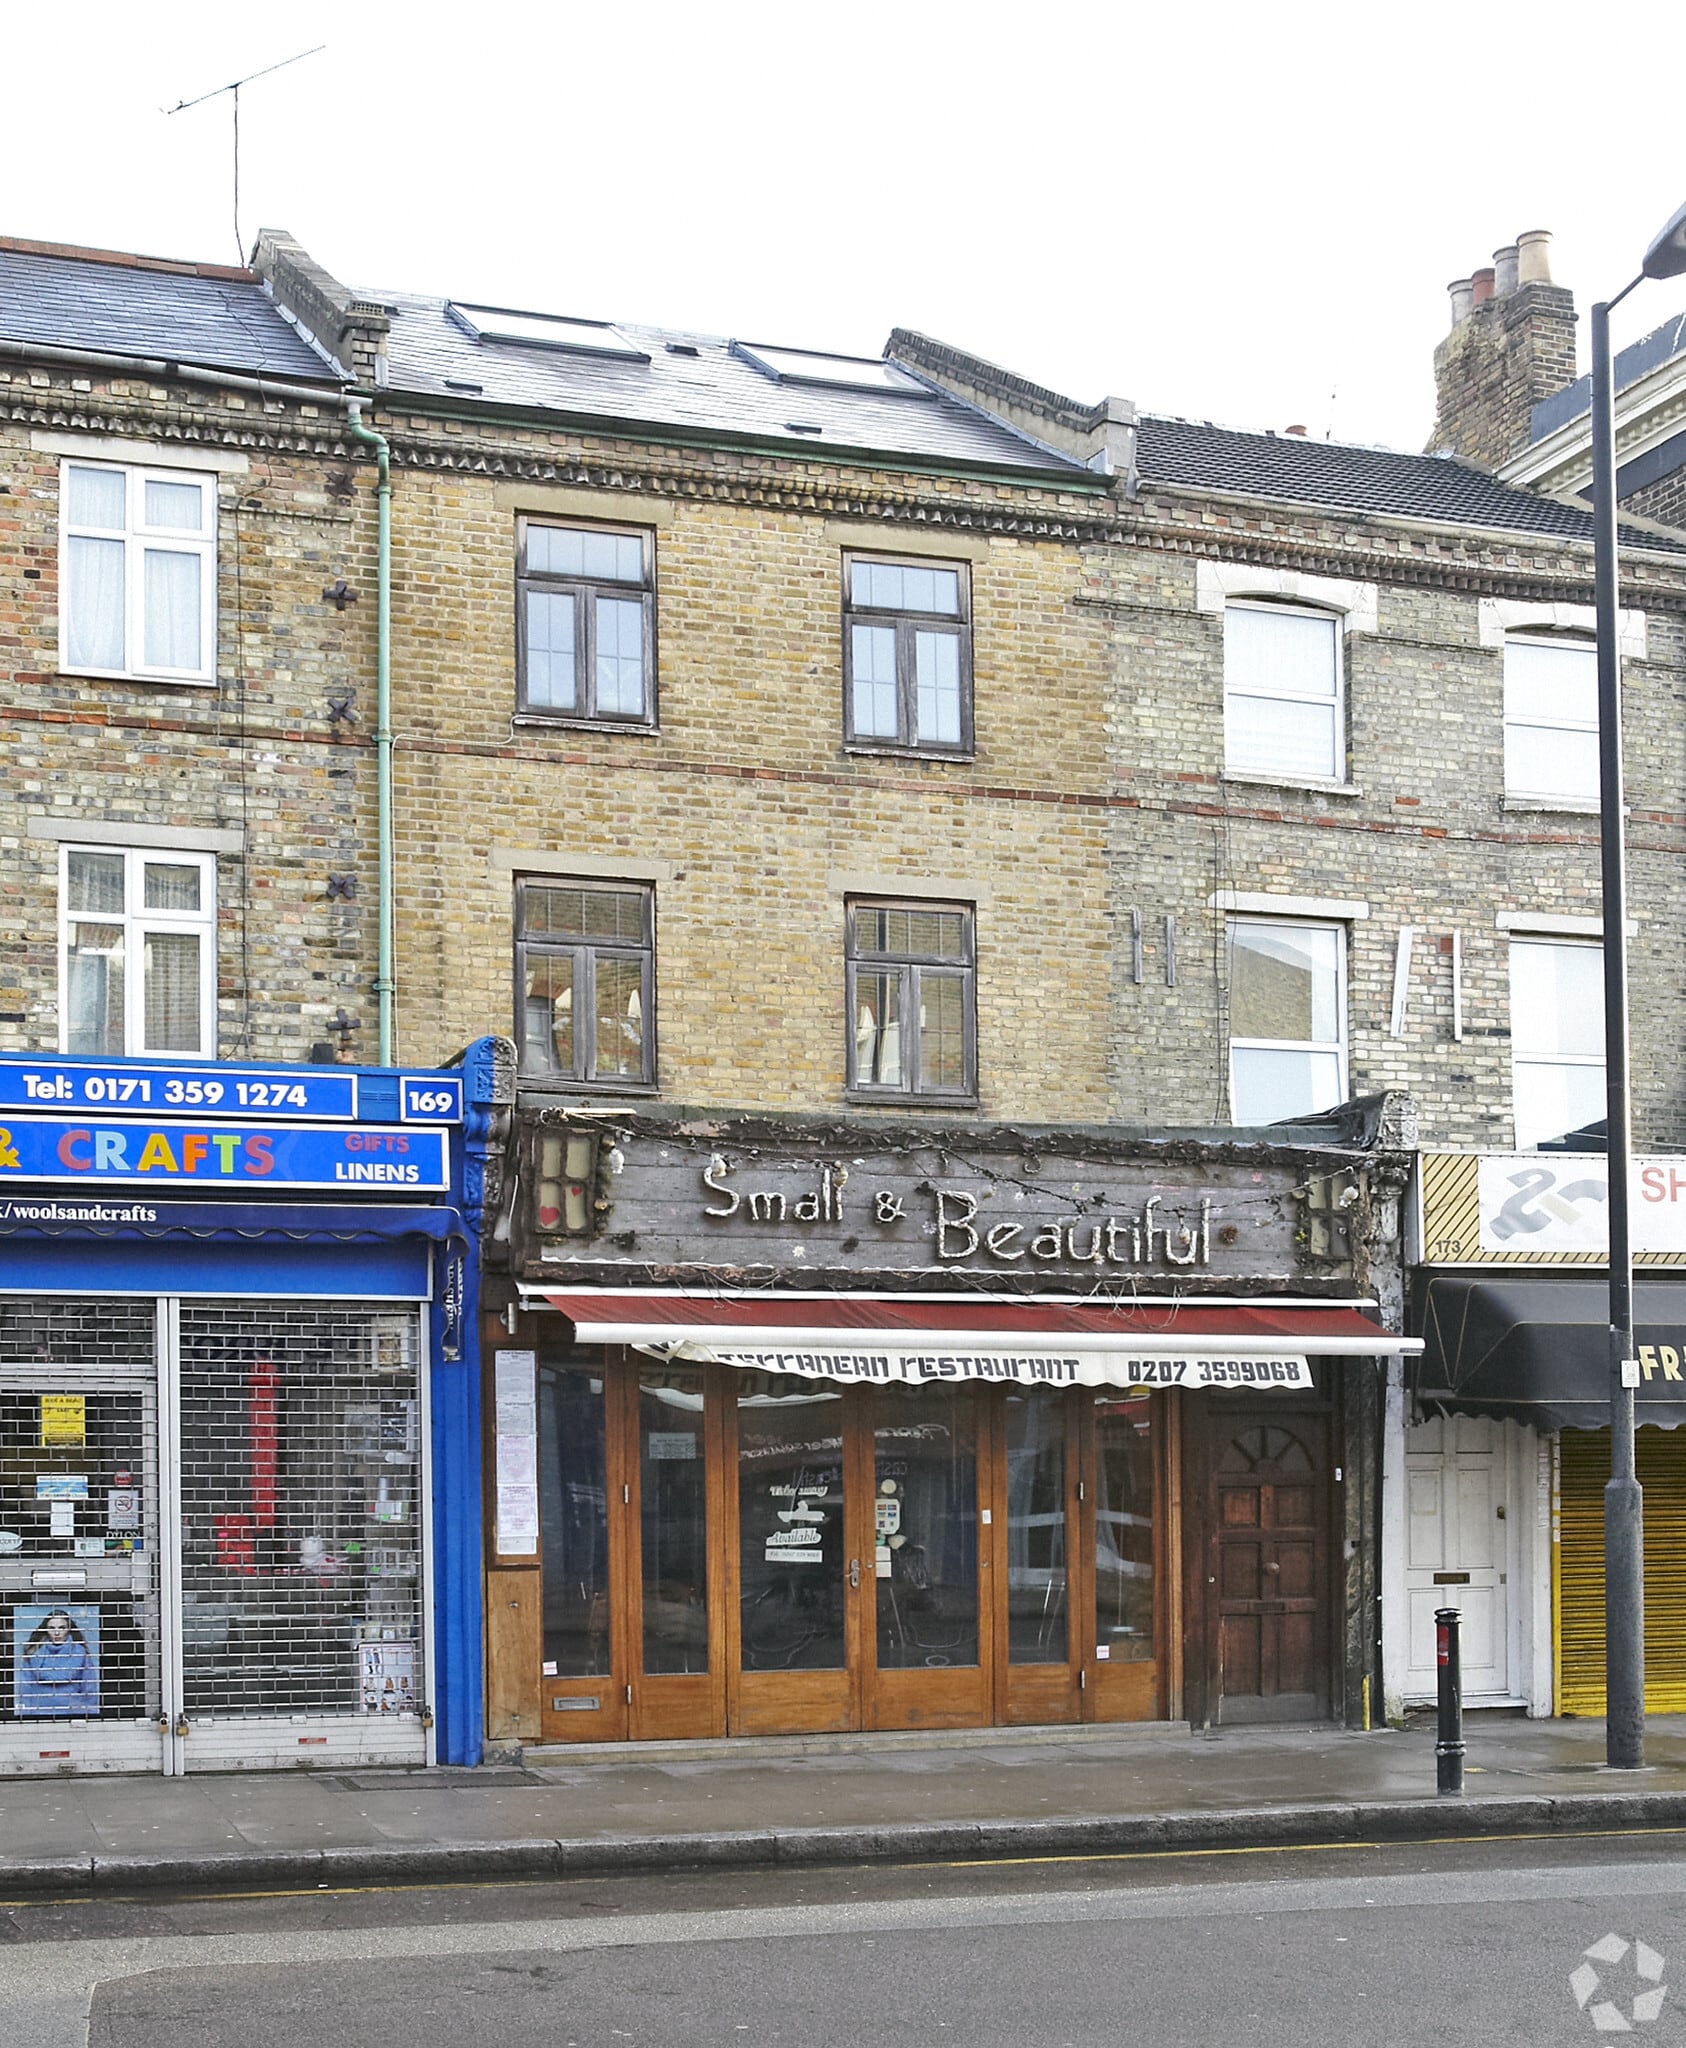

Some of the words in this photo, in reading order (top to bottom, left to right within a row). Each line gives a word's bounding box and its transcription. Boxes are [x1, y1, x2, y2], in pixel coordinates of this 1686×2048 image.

[22, 1074, 73, 1100] Tel:
[84, 1077, 151, 1102] 0171
[164, 1079, 225, 1105] 359
[235, 1082, 308, 1108] 1274
[409, 1091, 453, 1112] 169
[57, 1129, 275, 1176] CRAFTS
[344, 1133, 409, 1154] GIFTS
[335, 1162, 419, 1183] LINENS
[703, 1160, 843, 1221] Small
[875, 1190, 907, 1223] &
[937, 1190, 1211, 1264] Beautiful
[1435, 1240, 1461, 1254] 173
[1127, 1360, 1187, 1382] 0207
[1197, 1360, 1301, 1382] 3599068
[1638, 1345, 1686, 1380] FR
